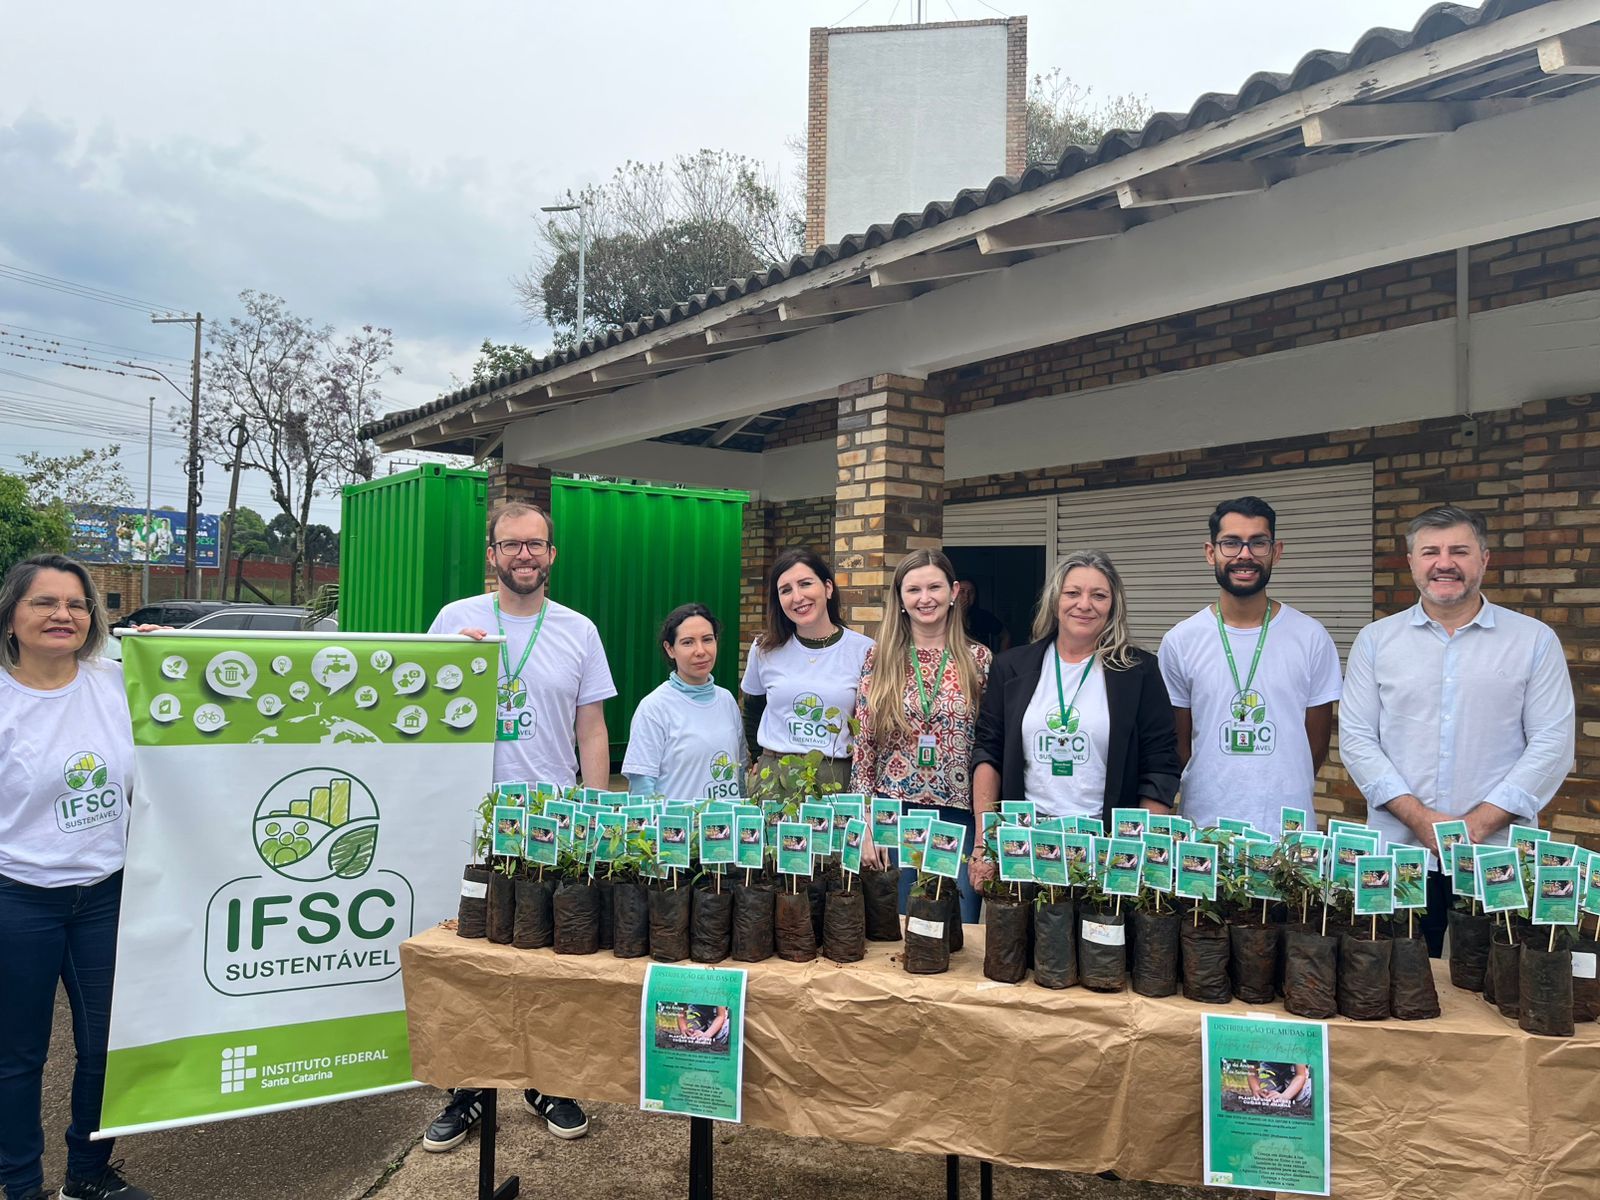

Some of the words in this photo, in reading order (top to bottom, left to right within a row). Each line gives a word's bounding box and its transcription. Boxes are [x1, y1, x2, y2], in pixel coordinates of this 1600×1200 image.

[789, 722, 827, 738] IFSC
[1039, 735, 1085, 752] IFC
[708, 782, 739, 800] IFSC
[61, 789, 117, 819] IFSC
[65, 809, 118, 829] SUSTENTÁVEL
[226, 888, 396, 952] IFSC
[225, 949, 396, 981] SUSTENTÁVEL
[1278, 1028, 1305, 1037] MUDAS
[1306, 1030, 1318, 1038] DE
[262, 1056, 331, 1077] INSTITUTO
[334, 1049, 389, 1066] FEDERAL
[261, 1076, 291, 1088] Santa
[292, 1070, 334, 1085] Catarina
